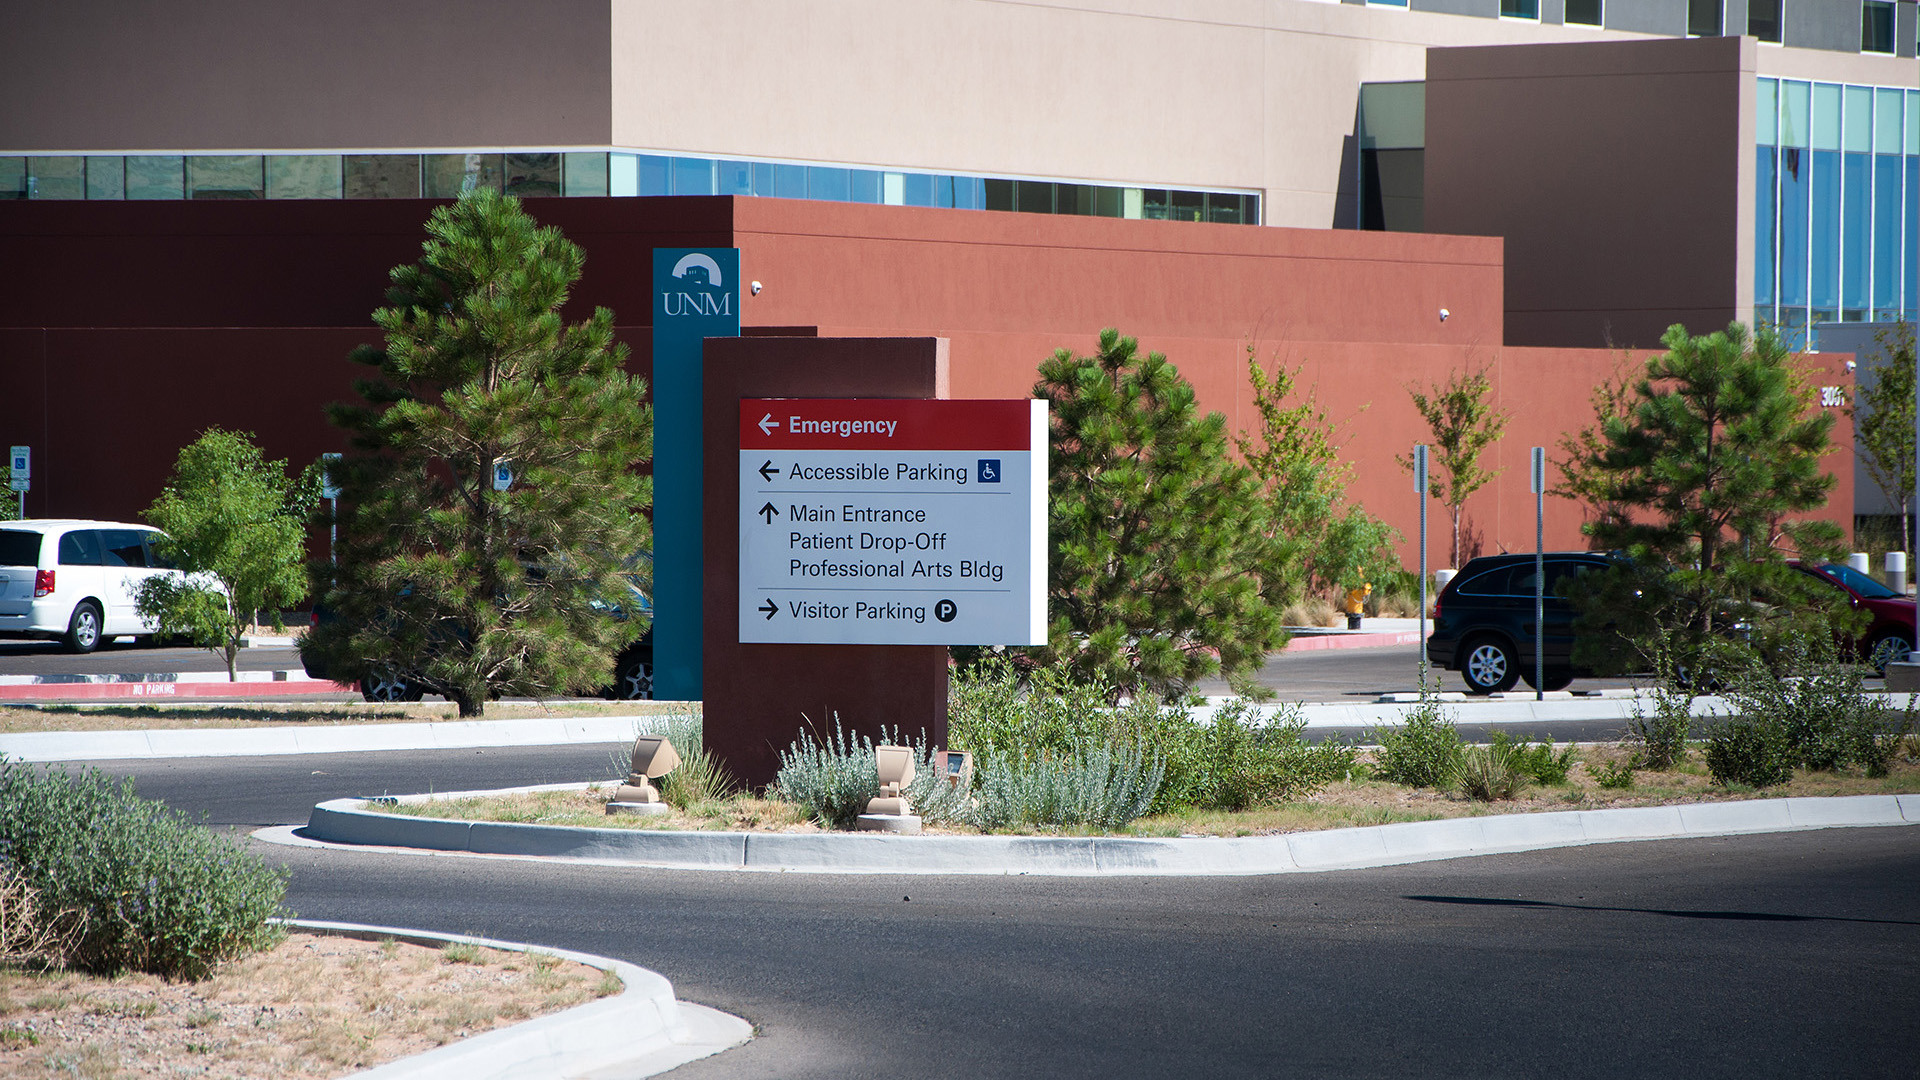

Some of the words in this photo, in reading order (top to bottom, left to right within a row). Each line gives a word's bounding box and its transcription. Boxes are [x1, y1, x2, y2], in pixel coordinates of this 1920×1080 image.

[662, 292, 732, 316] UNM
[789, 415, 898, 437] Emergency
[789, 462, 889, 481] Accessible
[896, 462, 968, 485] Parking
[790, 504, 835, 522] Main
[842, 504, 926, 523] Entrance
[790, 531, 854, 550] Patient
[860, 532, 947, 554] Drop-Off
[790, 559, 904, 578] Professional
[911, 560, 953, 578] Arts
[960, 560, 1003, 583] Bldg
[790, 600, 849, 619] Visitor
[856, 601, 926, 624] Parking
[941, 603, 953, 618] P
[132, 684, 143, 696] NO
[146, 683, 176, 695] PARKING
